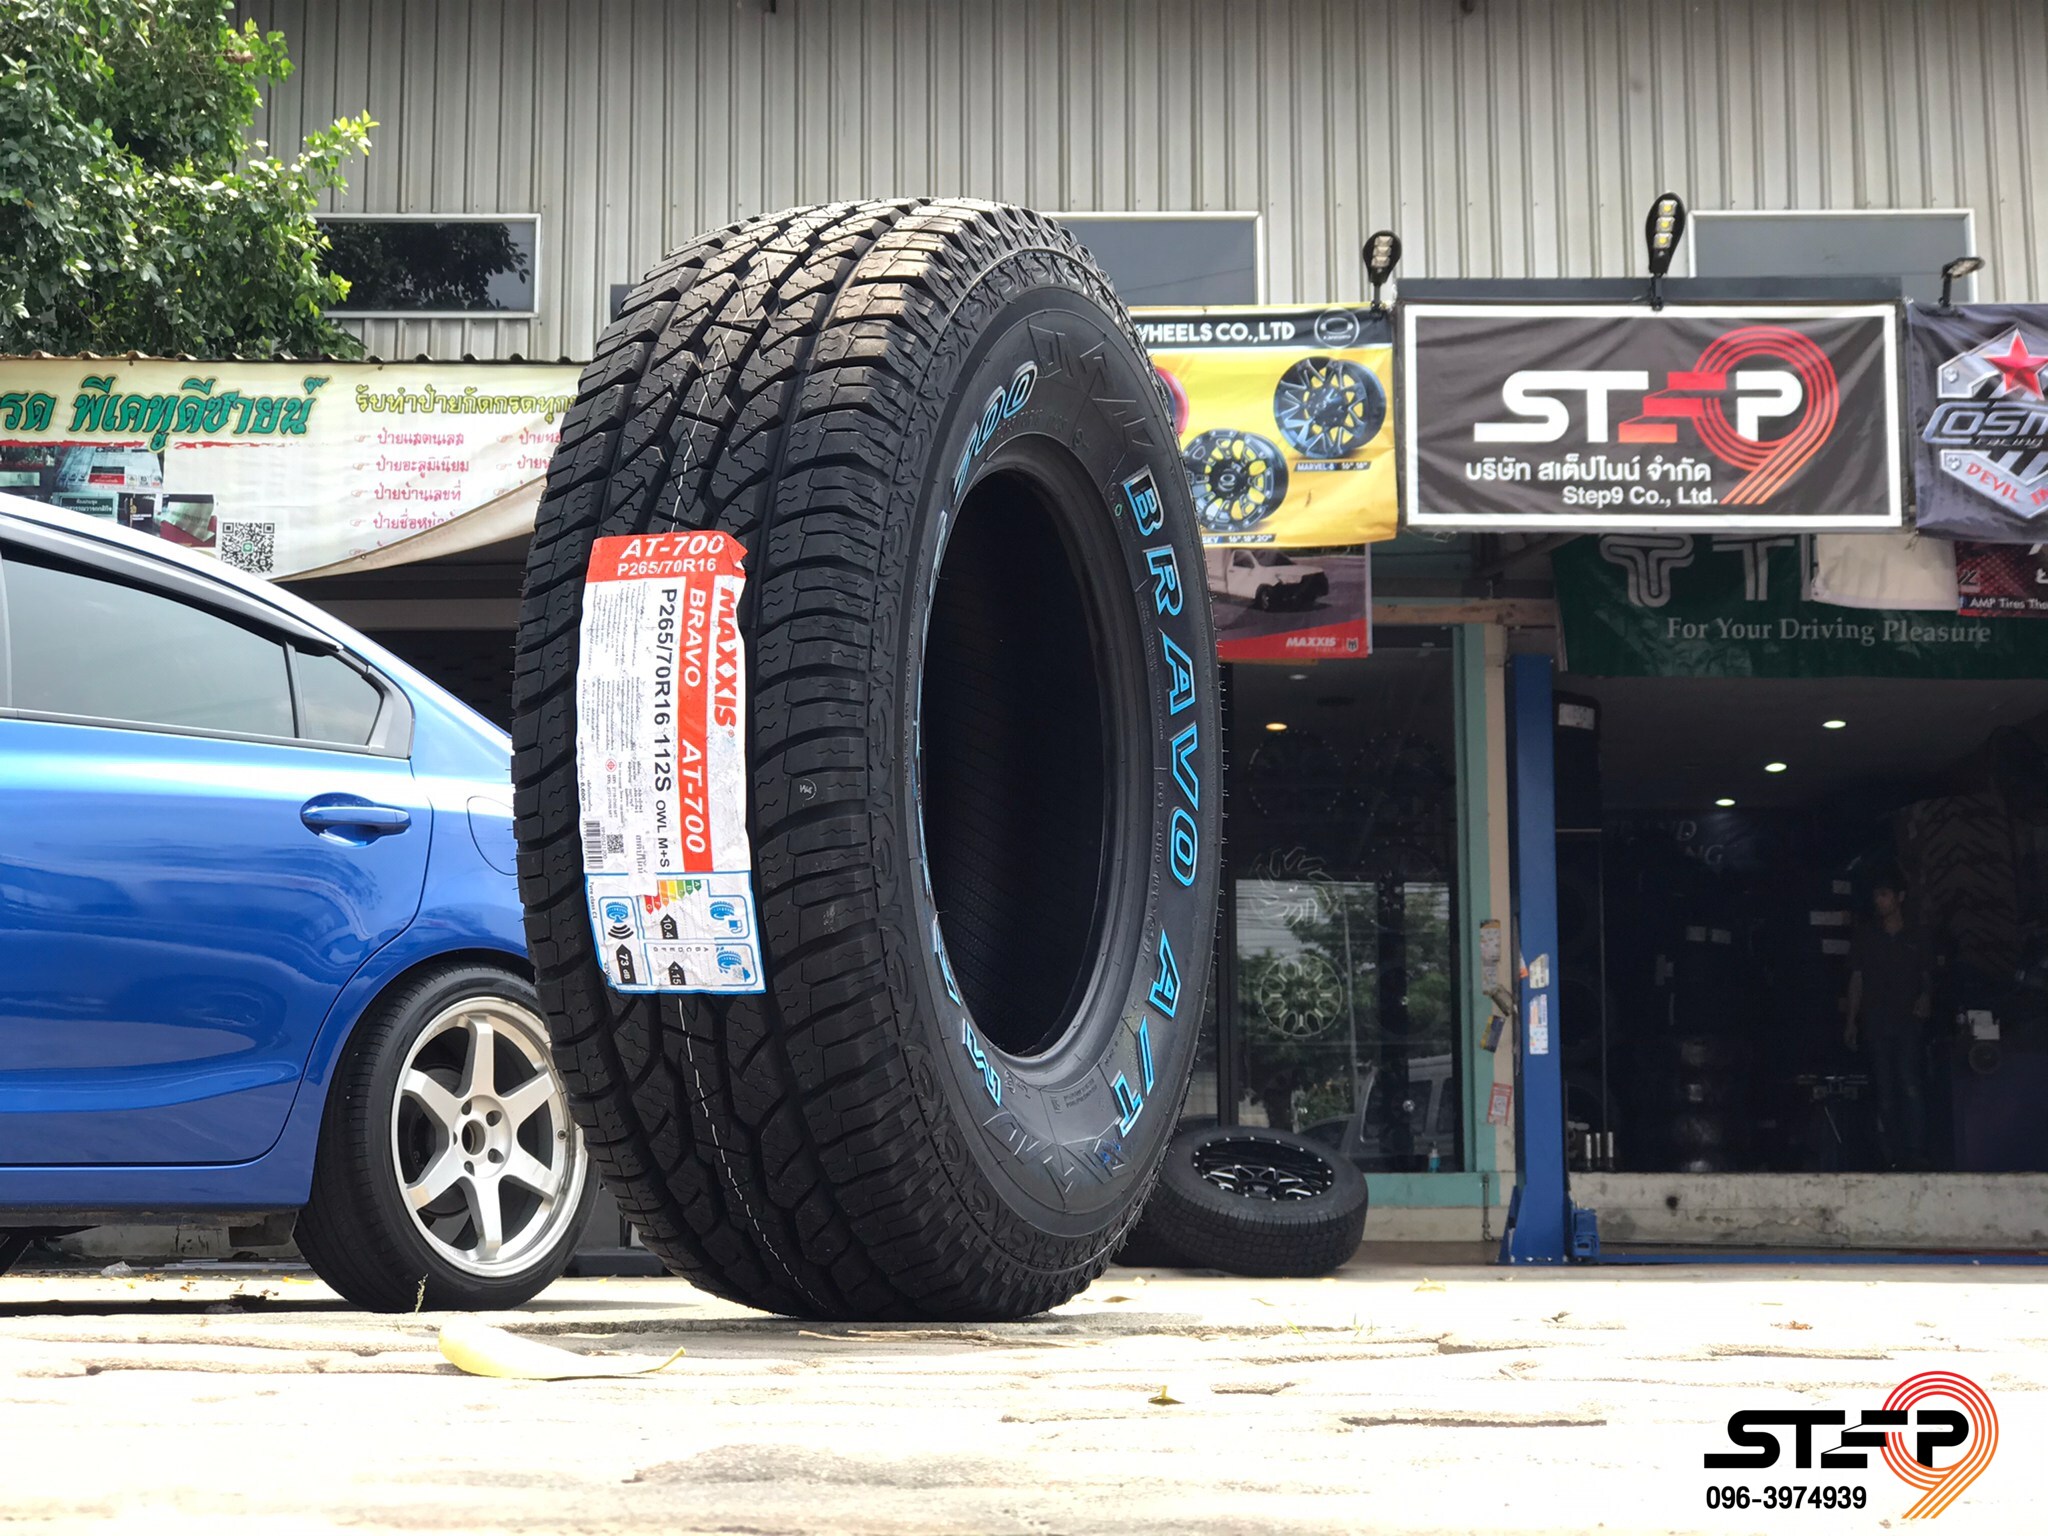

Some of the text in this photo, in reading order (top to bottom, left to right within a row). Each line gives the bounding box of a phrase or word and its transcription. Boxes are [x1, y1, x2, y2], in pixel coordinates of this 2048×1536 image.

[1465, 456, 1531, 482] บริษัท
[1646, 455, 1712, 482] จำกัด
[1966, 462, 2020, 504] DEVIL
[1562, 485, 1624, 508] Step9
[1677, 486, 1718, 505] Ltd.
[620, 535, 725, 559] AT-700
[617, 558, 717, 576] P265/70R16
[1286, 637, 1336, 647] MAXXIS
[1667, 617, 1991, 647] For Your Driving Pleasure
[714, 586, 738, 728] MAXXIS
[1121, 463, 1199, 887] BRAVO
[654, 588, 677, 868] P265/70R16 112S OWL M+S
[681, 587, 707, 854] BRAVO AT-700
[662, 918, 674, 939] 10.4
[618, 953, 630, 968] 73
[670, 965, 682, 985] 1.15
